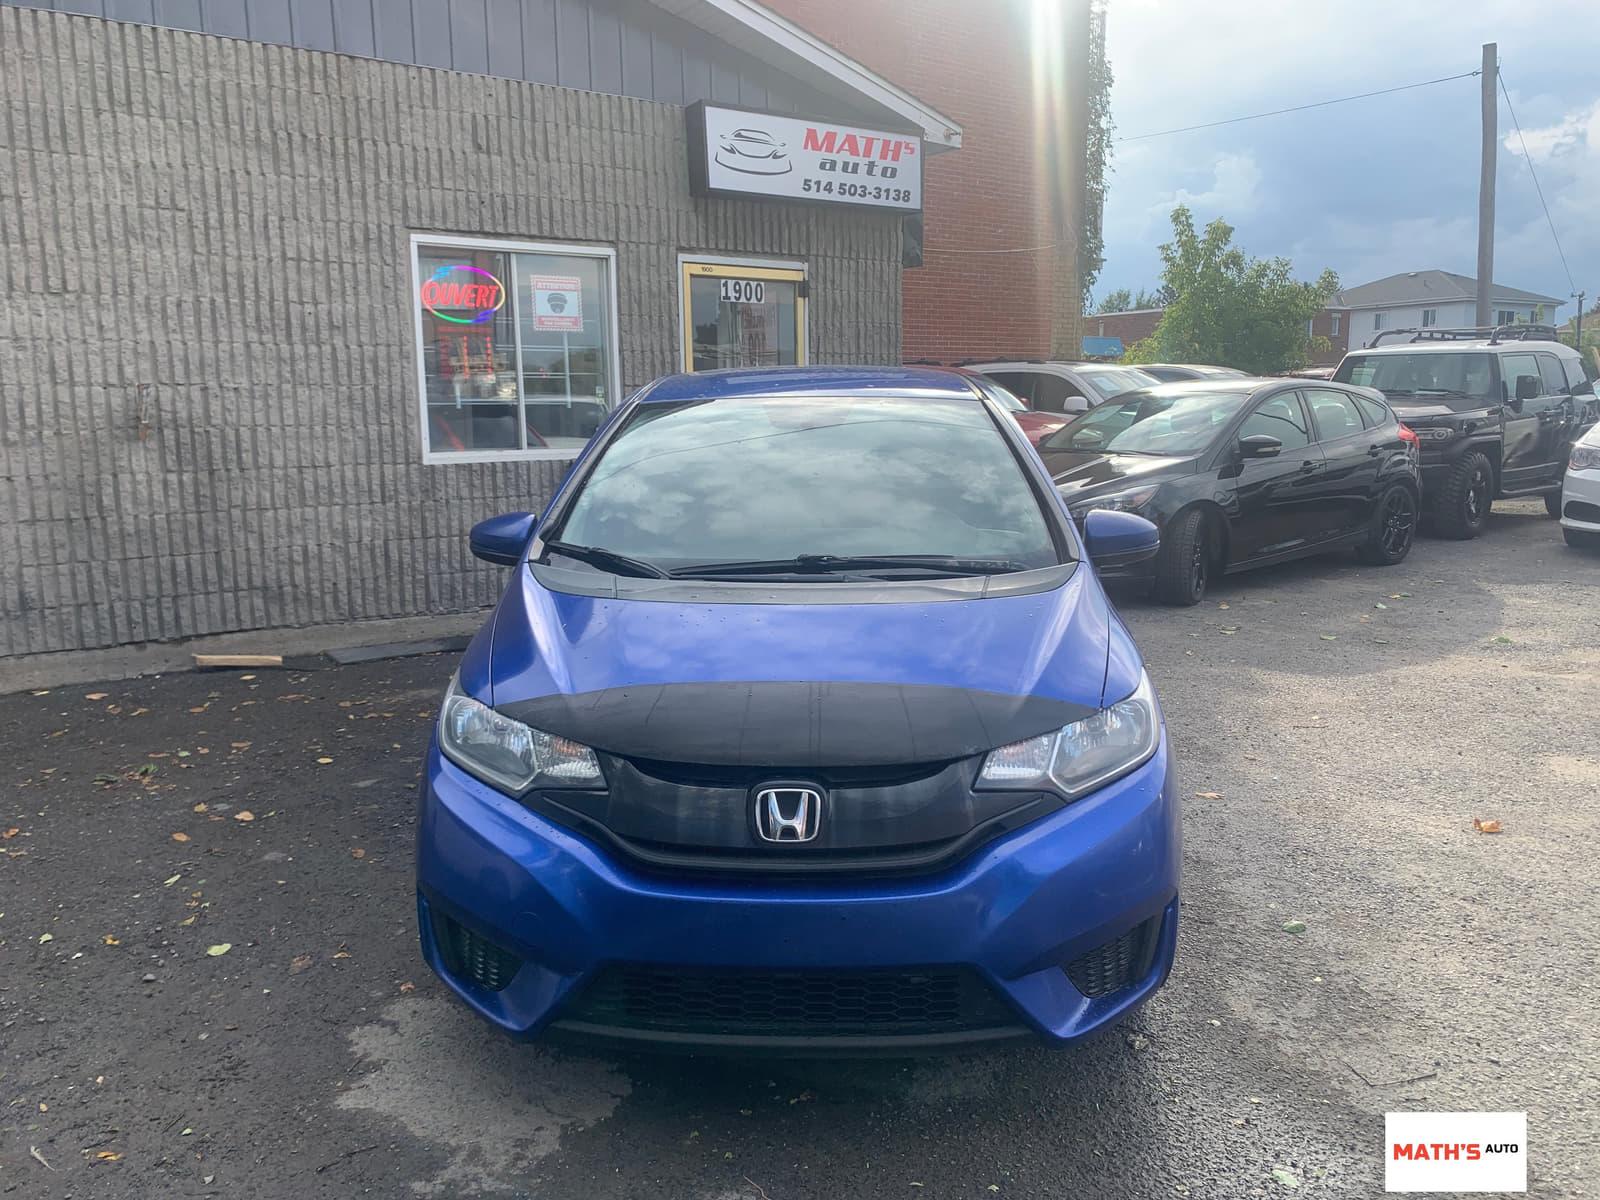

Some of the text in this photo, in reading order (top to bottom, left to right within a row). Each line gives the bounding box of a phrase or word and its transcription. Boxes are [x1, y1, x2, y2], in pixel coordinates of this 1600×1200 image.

[819, 158, 898, 179] auto
[803, 178, 911, 203] 514 503-3138
[421, 281, 499, 308] OUVERT
[722, 280, 763, 302] 1900
